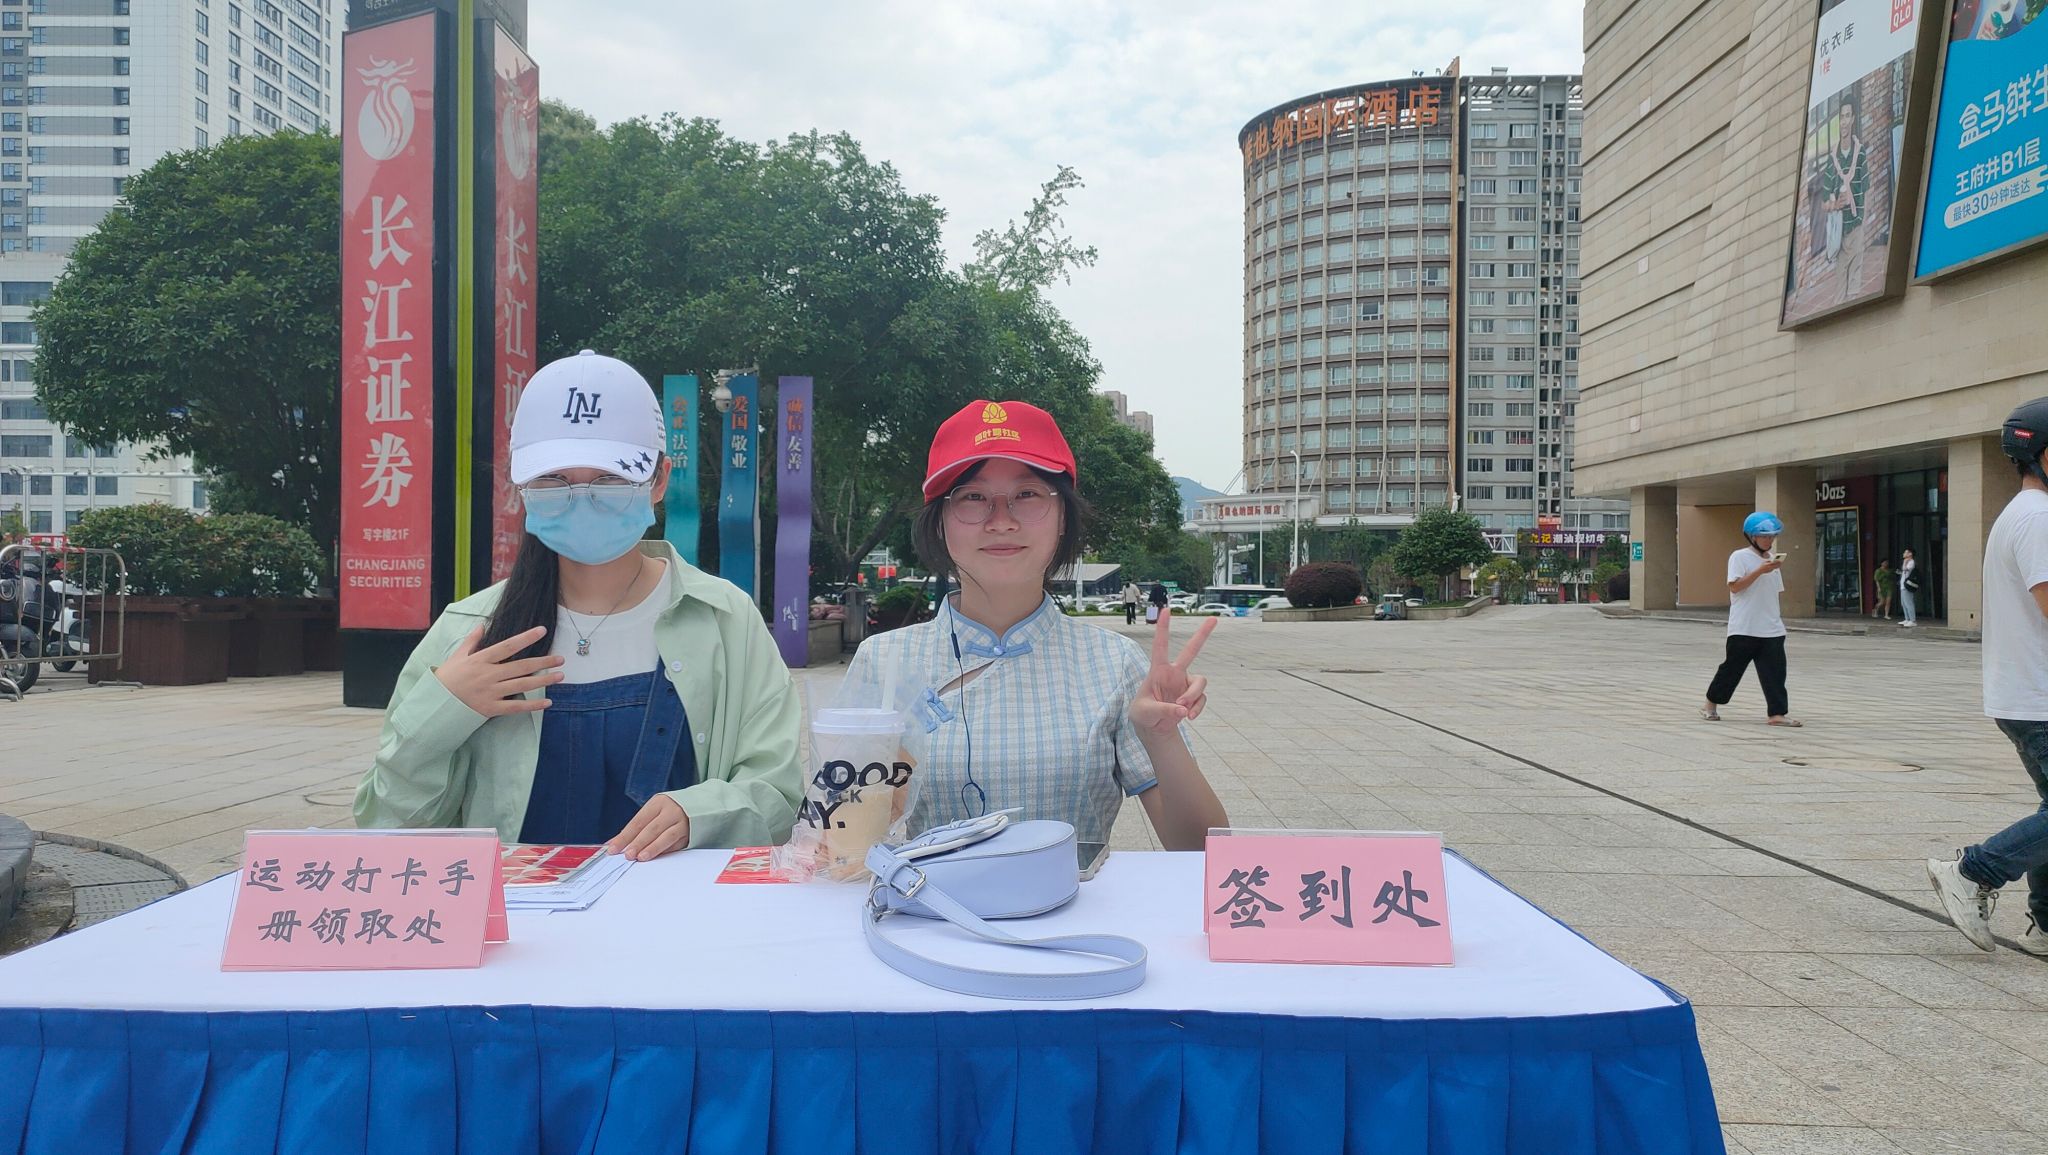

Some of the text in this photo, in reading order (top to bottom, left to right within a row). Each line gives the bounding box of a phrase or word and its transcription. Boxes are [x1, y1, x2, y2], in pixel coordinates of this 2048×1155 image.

[1820, 22, 1855, 58] 优衣库
[1958, 63, 2048, 150] 盒马鲜生
[1956, 137, 2041, 196] 王府井B1层
[1953, 178, 2031, 222] 最快30分钟送达
[361, 194, 414, 508] 长江证券
[363, 528, 410, 541] 写字楼21F
[346, 559, 425, 571] CHANGJIANG
[349, 576, 422, 588] SECURITIES
[246, 857, 475, 896] 运动打卡手
[1214, 865, 1441, 928] 签到处
[258, 908, 445, 945] 册领取处
